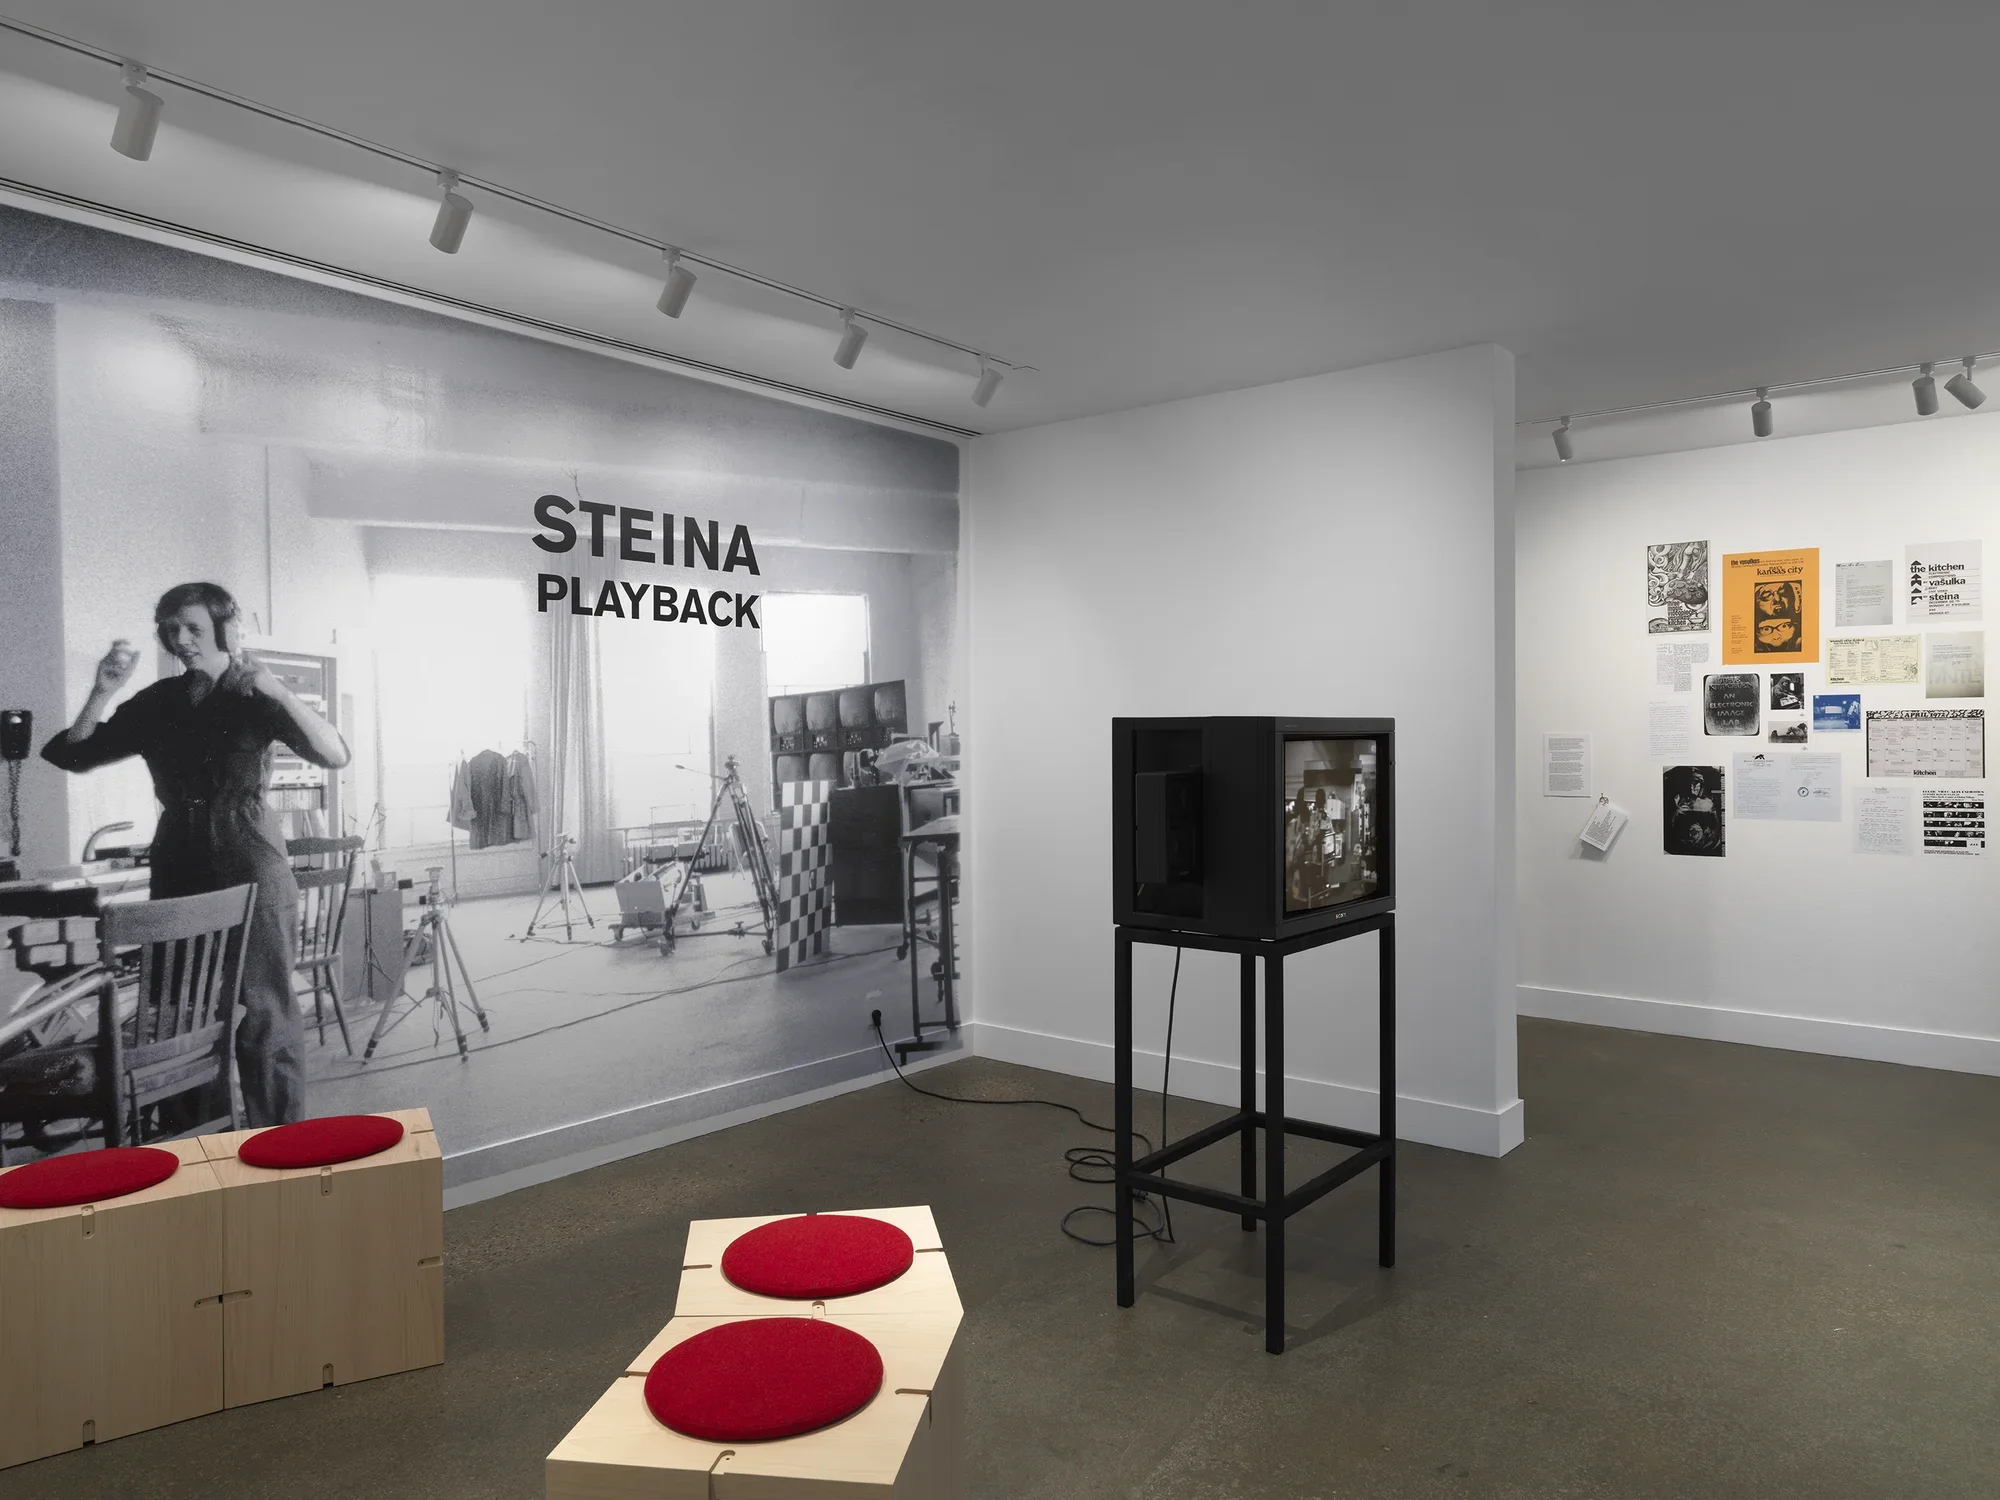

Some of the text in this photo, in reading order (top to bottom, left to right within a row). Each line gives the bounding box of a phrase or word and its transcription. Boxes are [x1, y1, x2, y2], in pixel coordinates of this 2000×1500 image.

[532, 494, 761, 576] STEINA
[1756, 566, 1786, 576] kansas
[1788, 566, 1804, 574] city
[1929, 578, 1966, 586] vašulka
[538, 573, 760, 629] PLAYBACK
[1929, 592, 1960, 601] steina
